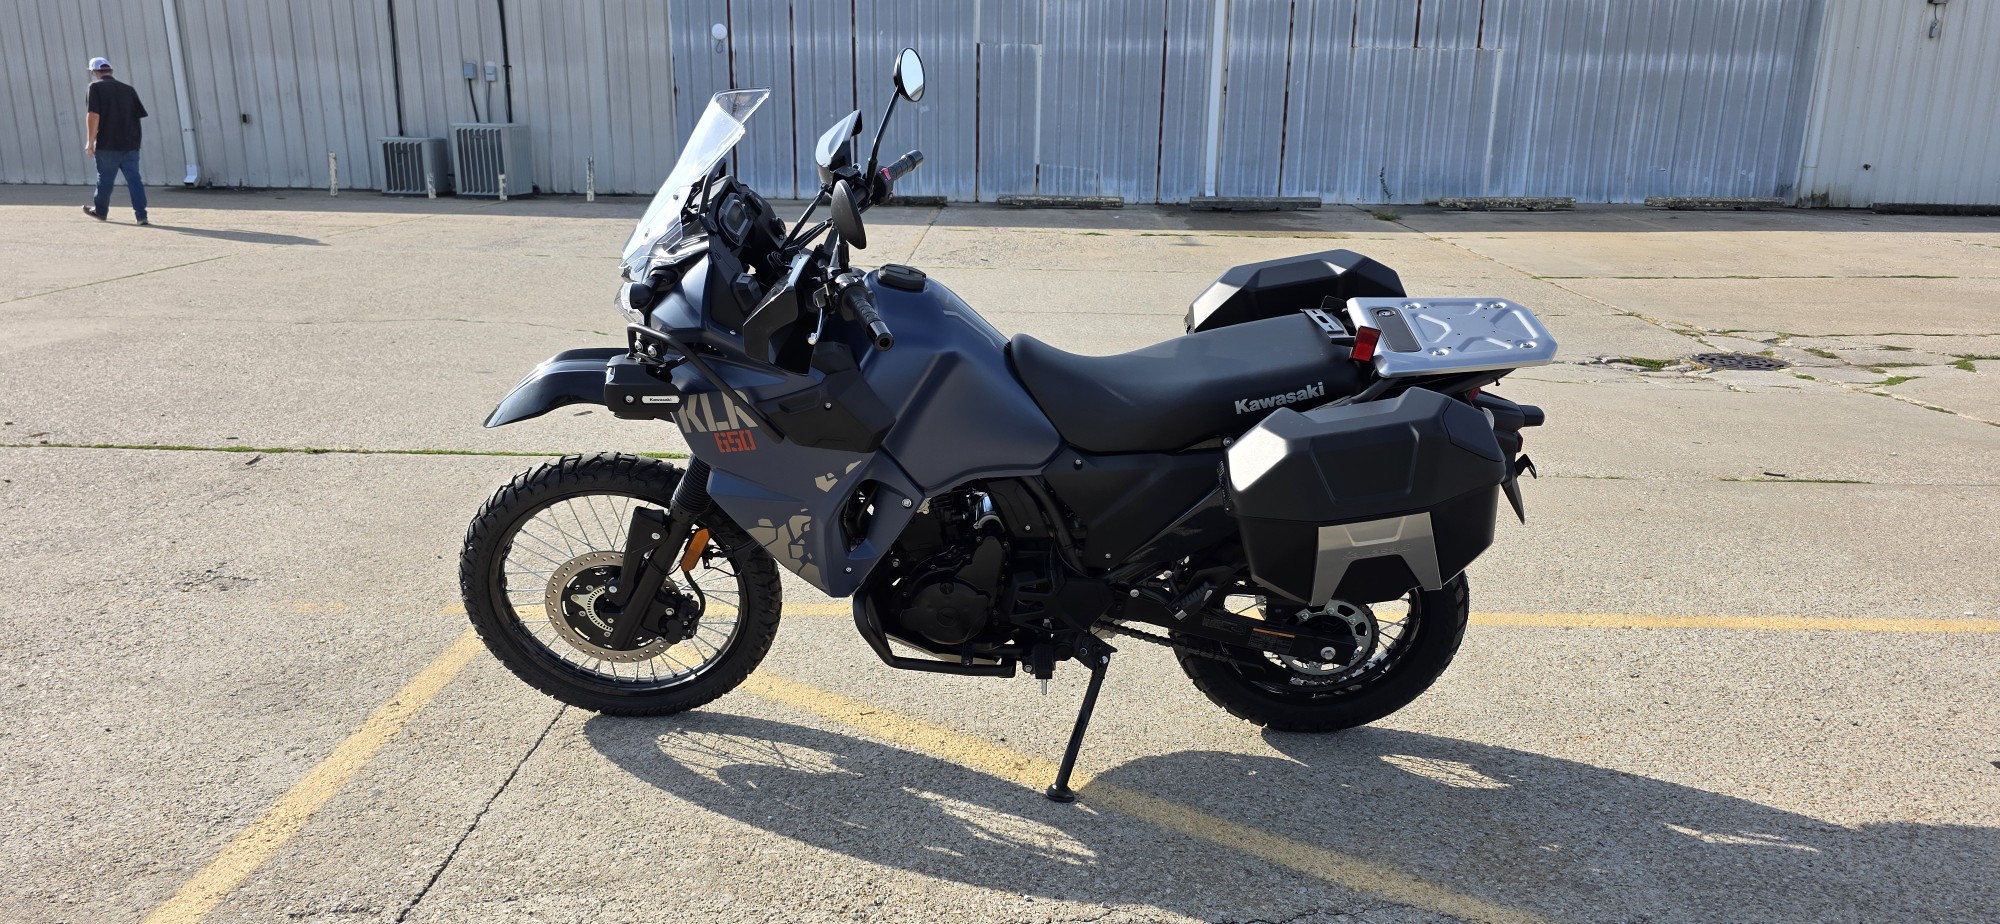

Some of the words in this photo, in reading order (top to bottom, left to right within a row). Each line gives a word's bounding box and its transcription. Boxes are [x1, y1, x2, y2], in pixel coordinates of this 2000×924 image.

[678, 390, 758, 433] KLR
[1234, 381, 1325, 415] Kawasaki
[714, 429, 757, 453] 650
